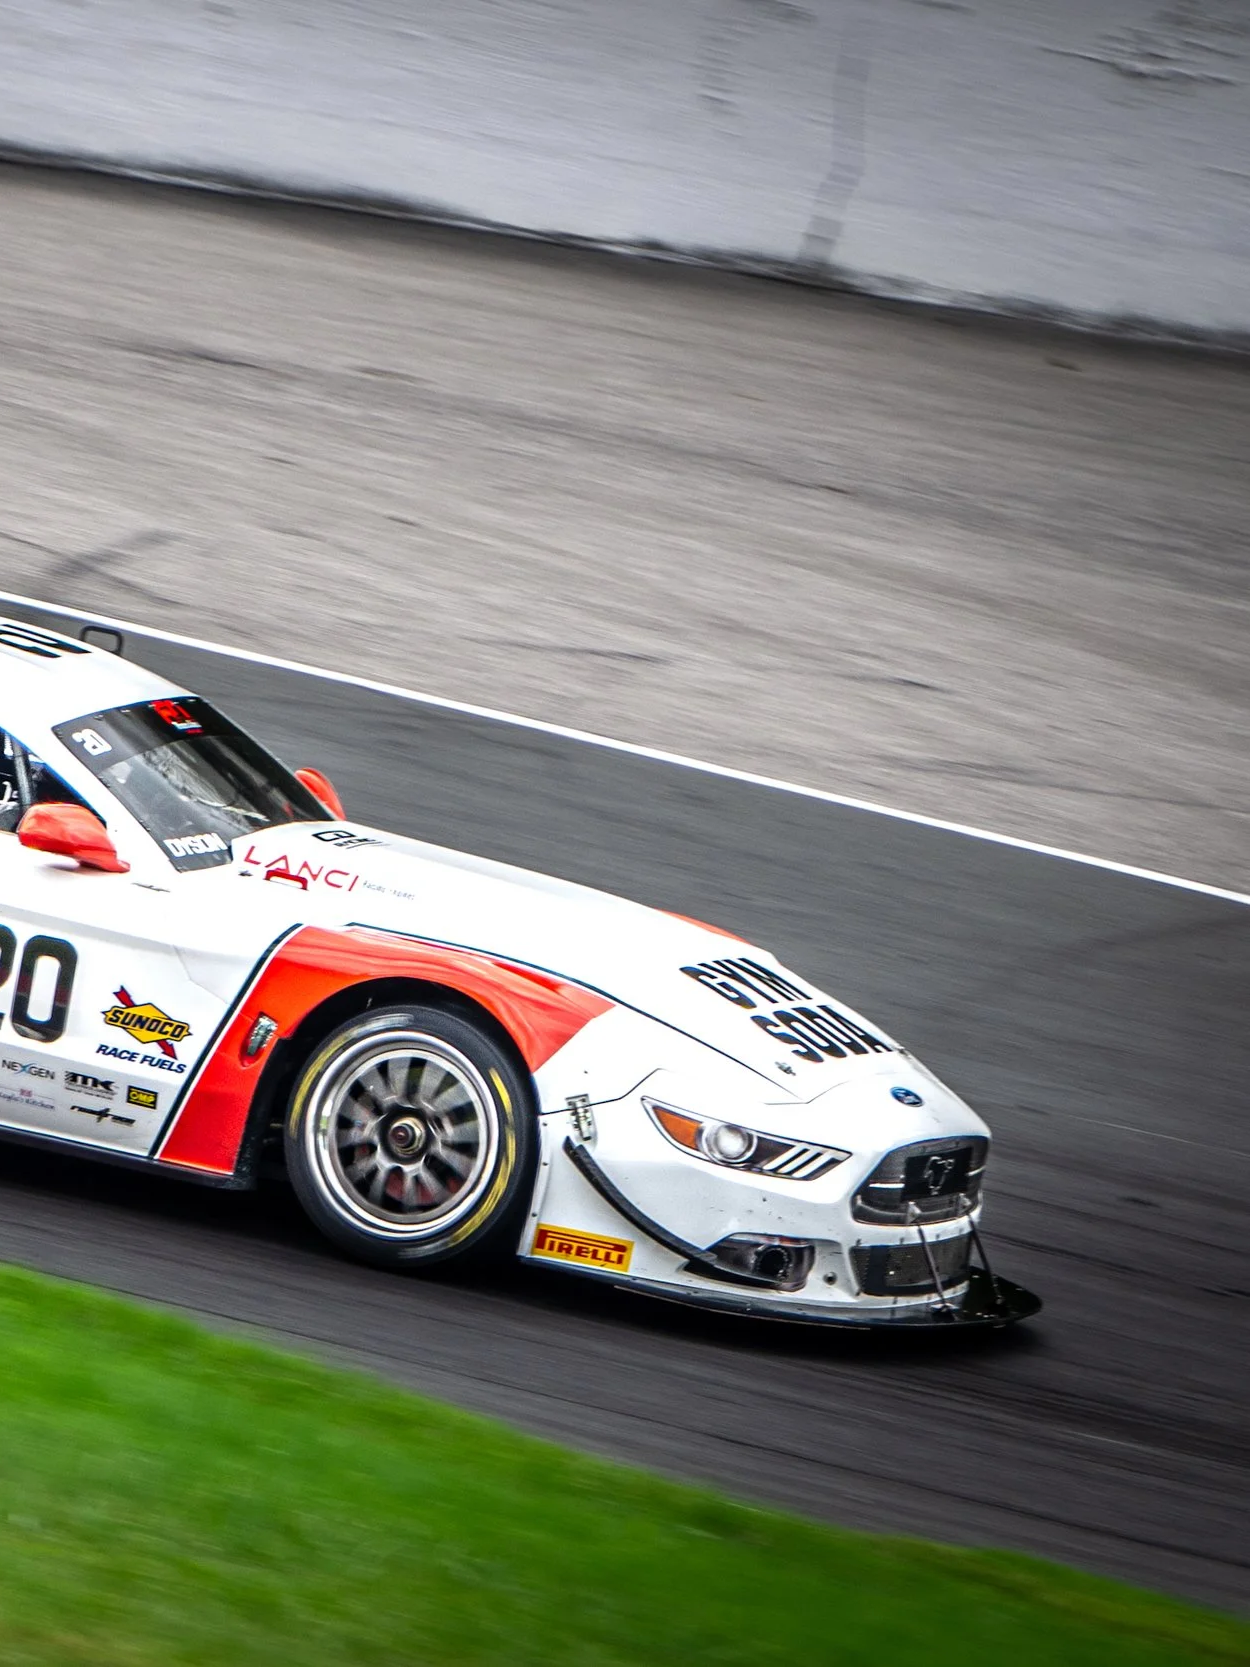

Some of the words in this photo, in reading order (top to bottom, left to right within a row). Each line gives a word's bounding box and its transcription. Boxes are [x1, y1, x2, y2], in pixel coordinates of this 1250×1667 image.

[163, 832, 228, 857] DYSON
[244, 845, 359, 892] LANCI
[679, 957, 813, 1009] GYM
[108, 1009, 186, 1038] SUNOCO
[750, 1005, 893, 1063] SODA
[1, 1059, 56, 1080] NEXGEN
[95, 1044, 140, 1062] RACE
[139, 1054, 187, 1073] FUELS
[535, 1228, 628, 1265] PIRELLI
